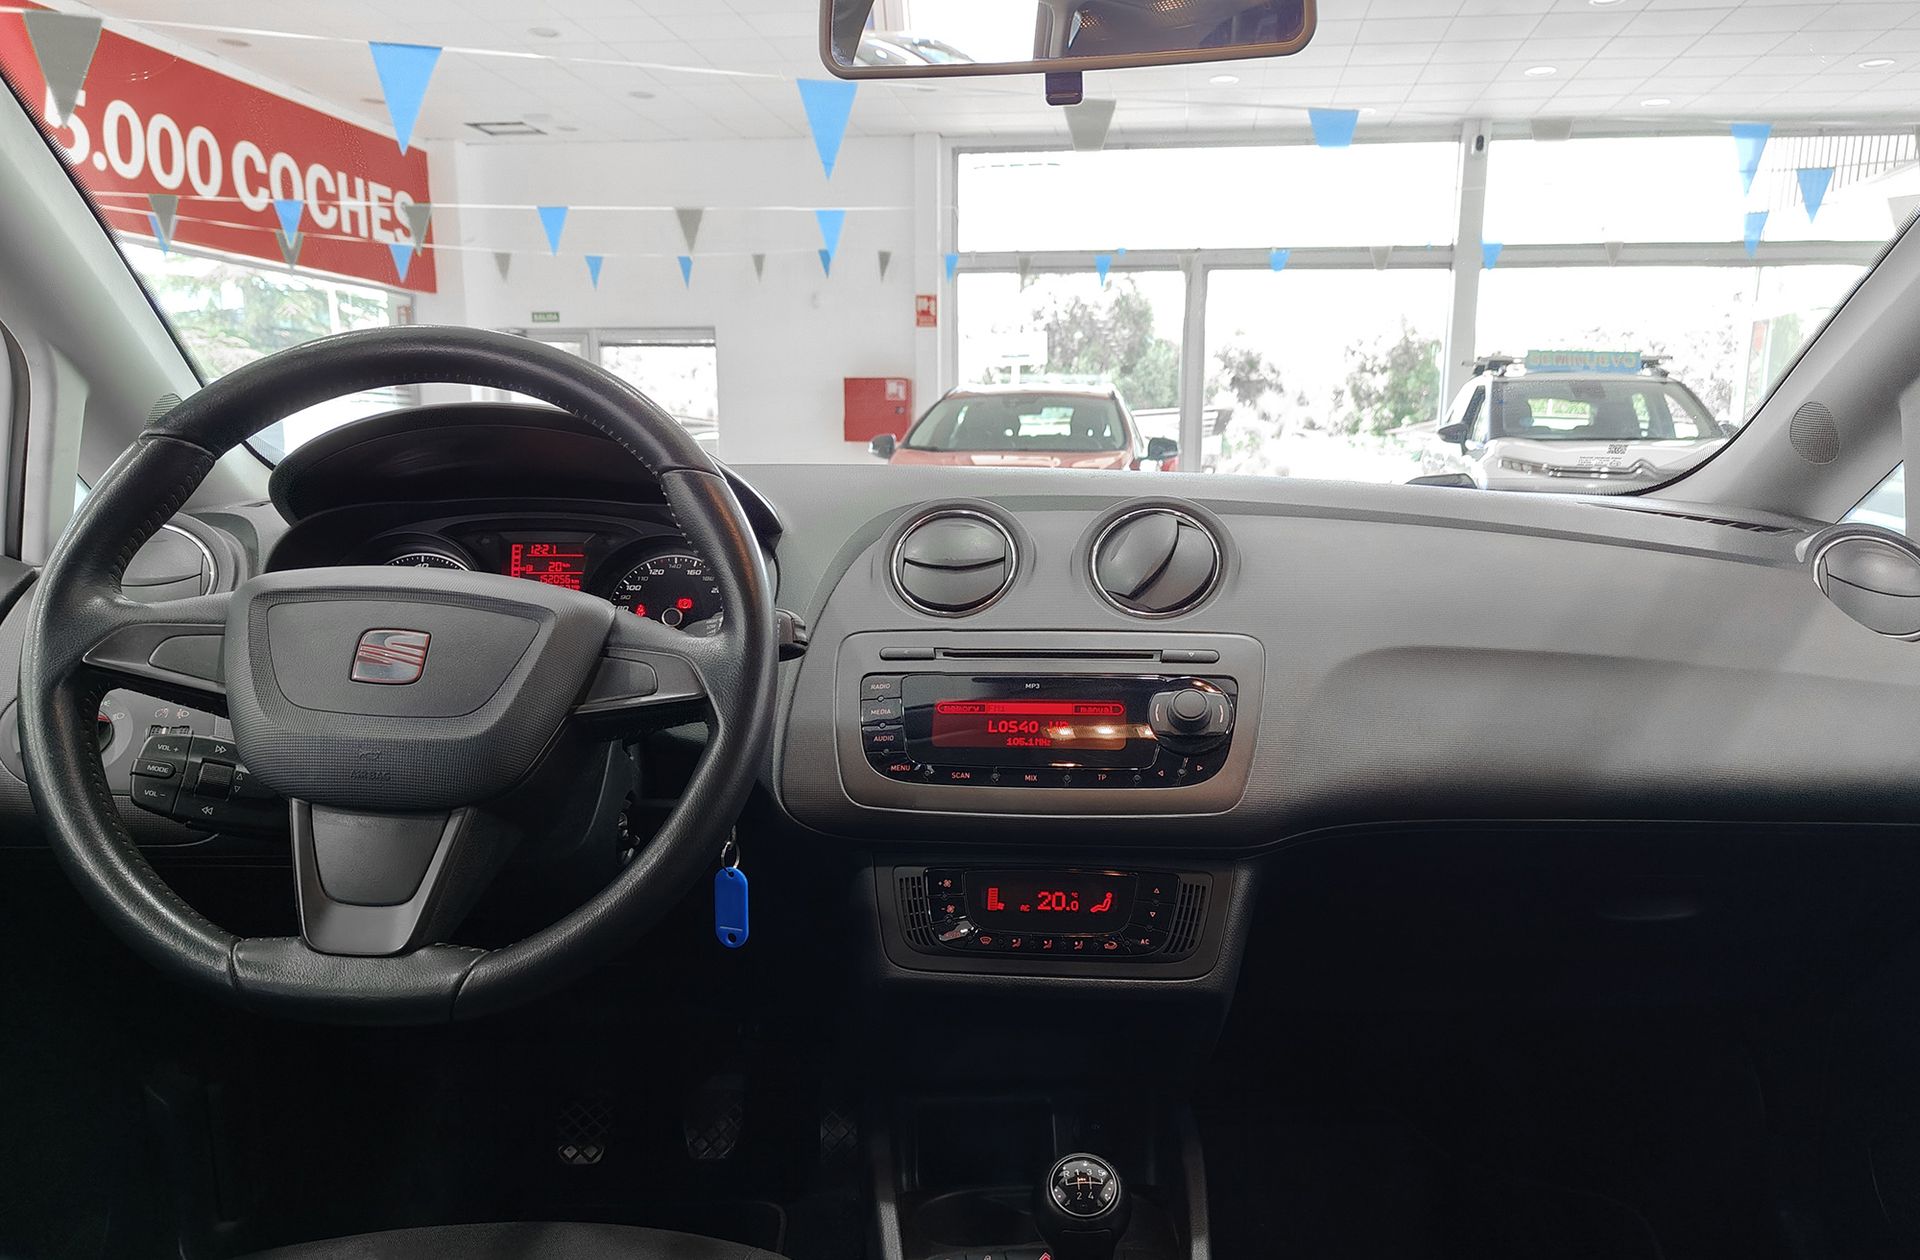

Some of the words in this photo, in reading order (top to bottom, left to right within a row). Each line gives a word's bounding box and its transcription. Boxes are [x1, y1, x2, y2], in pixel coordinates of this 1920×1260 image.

[231, 140, 417, 245] COCHES
[987, 720, 1039, 734] LOS40
[157, 744, 171, 752] VOL
[147, 764, 170, 774] MODE
[144, 789, 158, 797] VOL
[1086, 1168, 1093, 1176] 3
[1076, 1192, 1082, 1200] 2
[1087, 1191, 1094, 1199] 4
